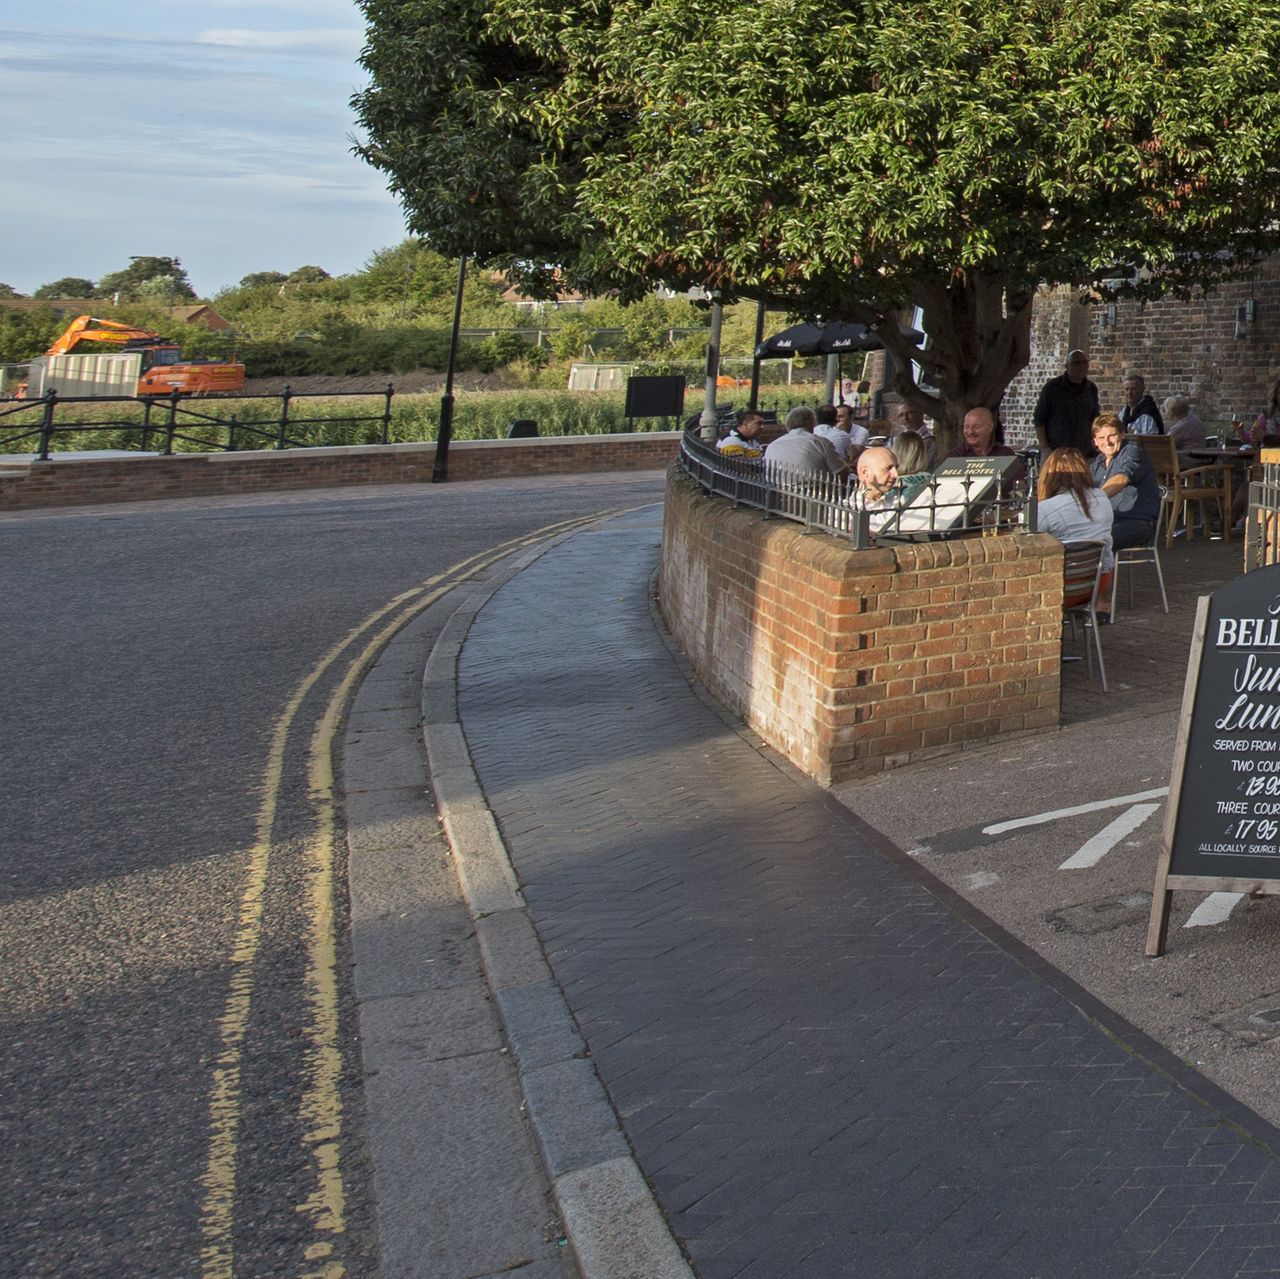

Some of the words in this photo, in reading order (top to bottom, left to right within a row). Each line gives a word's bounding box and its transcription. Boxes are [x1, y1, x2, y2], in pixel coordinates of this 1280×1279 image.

[1213, 739, 1249, 751] SERVED
[1250, 740, 1276, 751] FROM
[1231, 760, 1254, 772] TWO
[1217, 801, 1248, 815] THREE
[1199, 843, 1212, 851] ALL
[1214, 844, 1246, 853] LOCALLY
[1248, 845, 1276, 854] SOURCE
